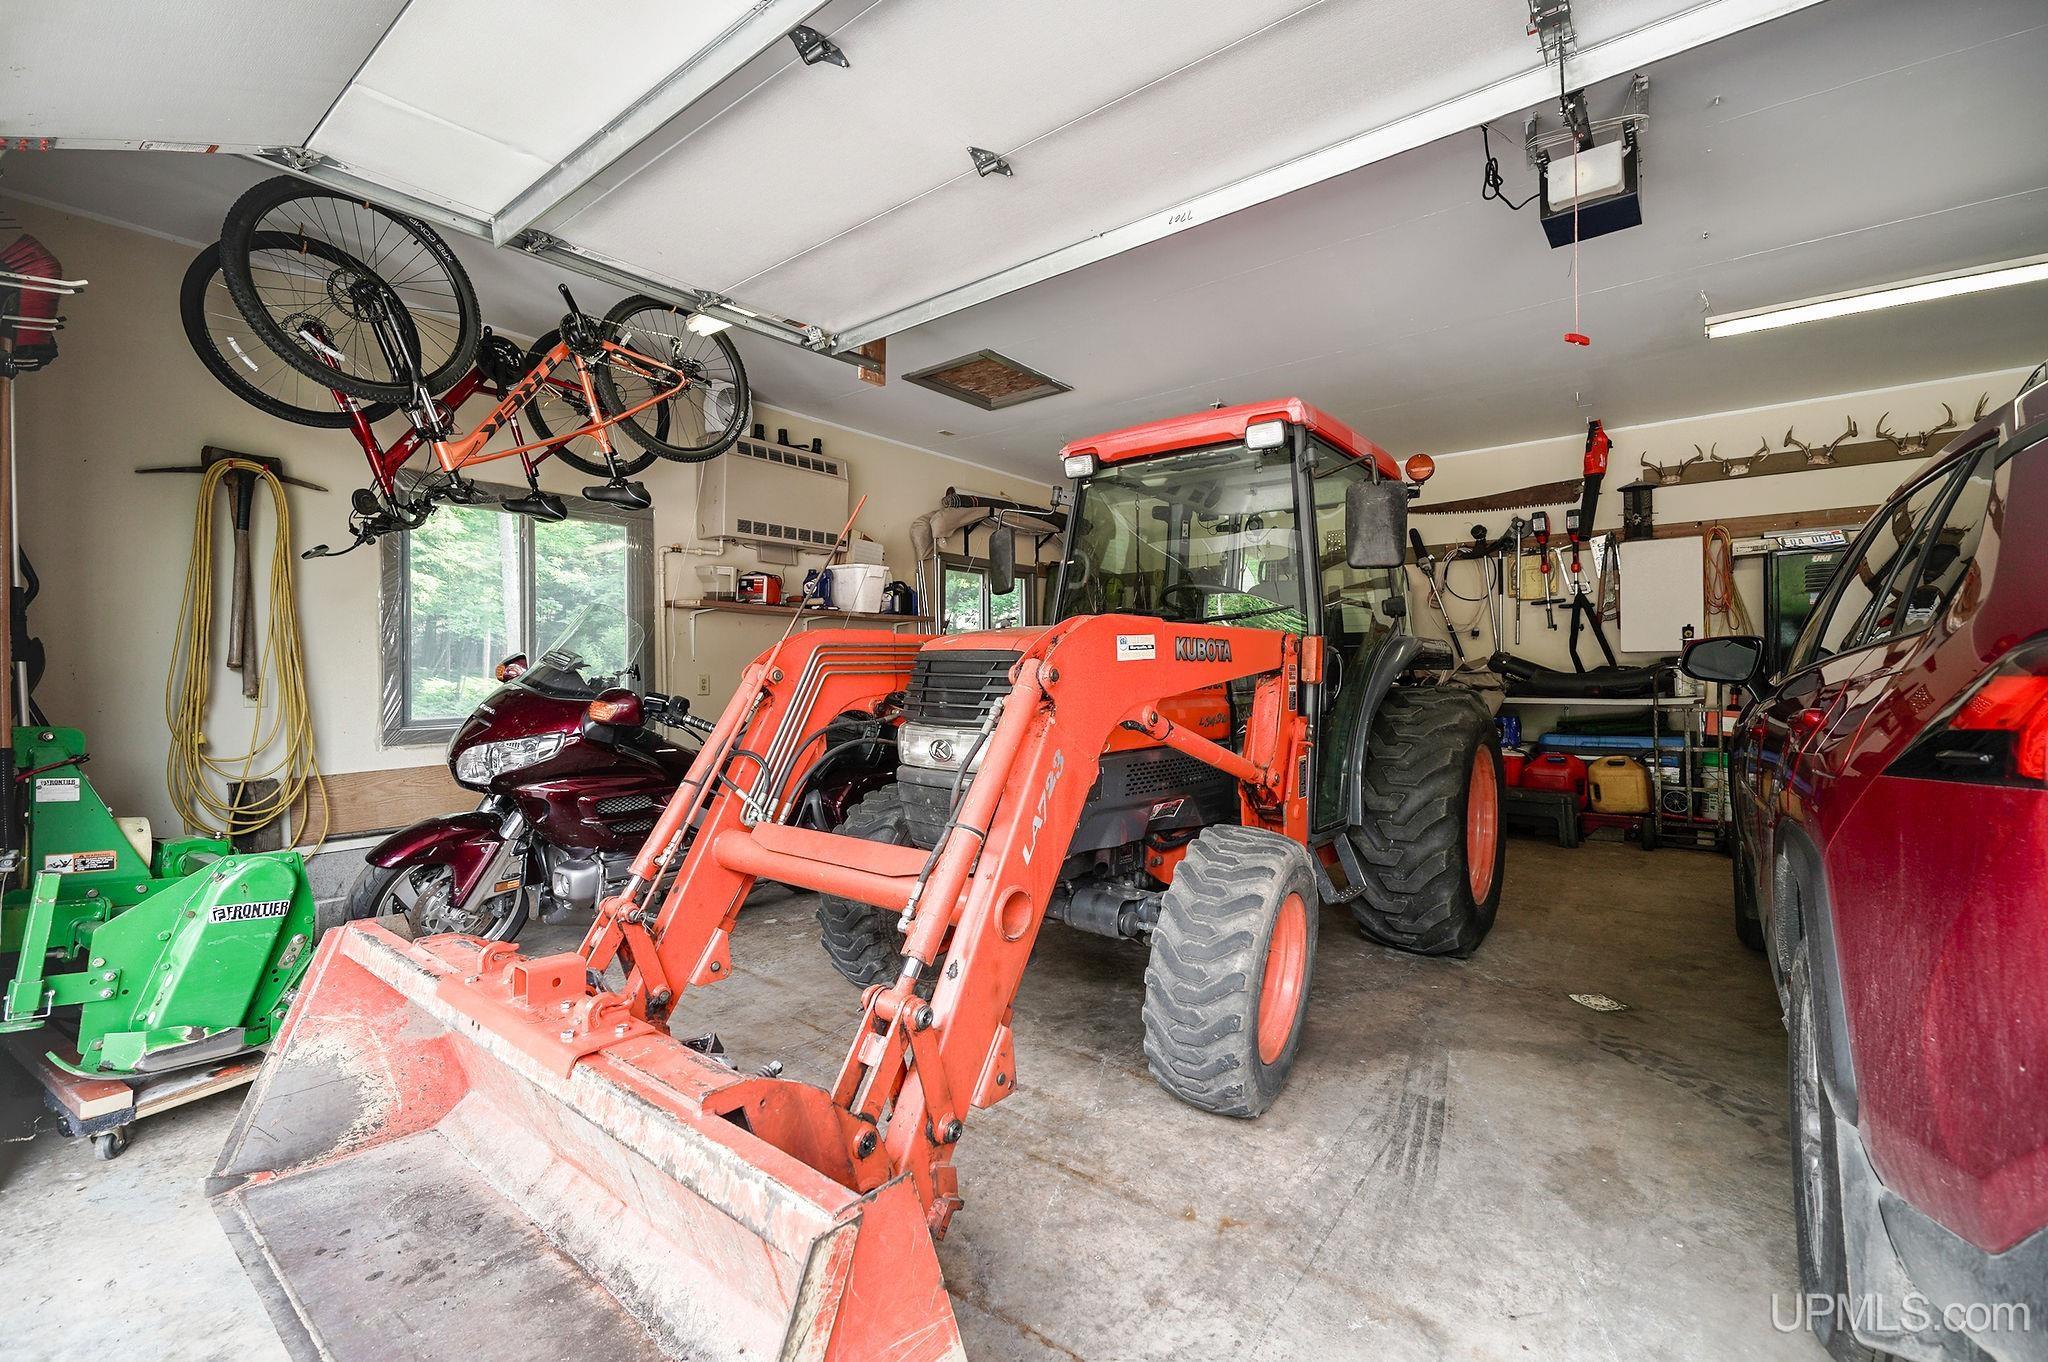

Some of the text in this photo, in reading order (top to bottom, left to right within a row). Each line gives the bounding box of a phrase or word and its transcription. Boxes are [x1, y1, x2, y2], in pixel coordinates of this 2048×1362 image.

[409, 217, 453, 262] XR2 COMP
[1175, 636, 1232, 662] KUBOTA
[1022, 748, 1065, 867] LA723
[226, 901, 290, 921] FRONTIER
